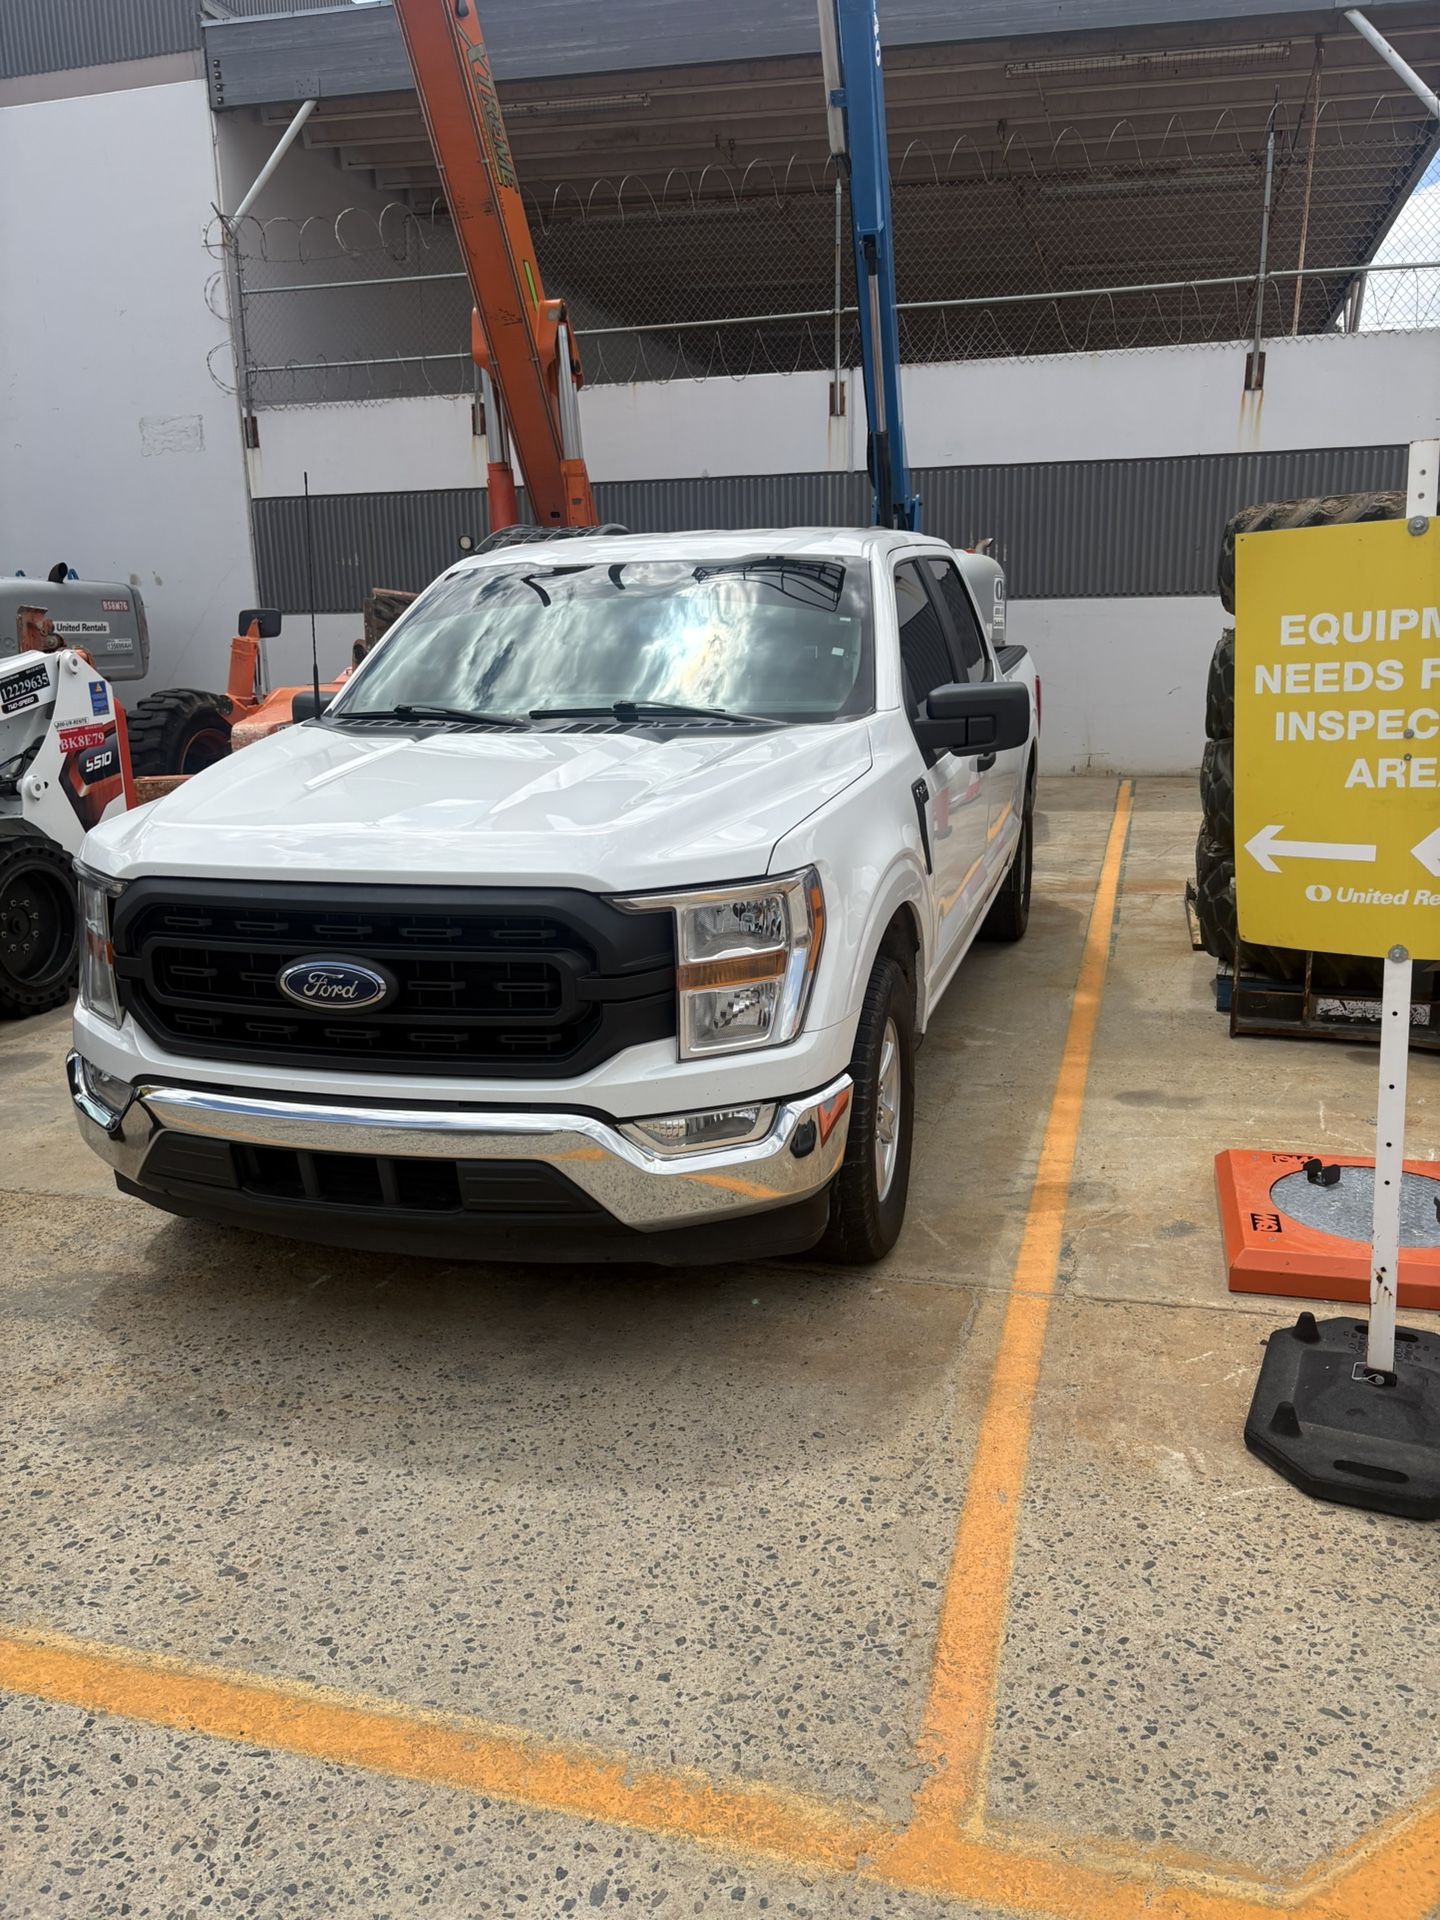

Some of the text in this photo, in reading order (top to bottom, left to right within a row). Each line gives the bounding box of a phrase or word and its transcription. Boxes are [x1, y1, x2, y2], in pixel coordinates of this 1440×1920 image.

[56, 623, 107, 632] United Rentals
[1, 672, 50, 700] 12229635
[1255, 659, 1404, 694] NEEDS
[8, 696, 35, 711] TWO-SPEED
[1275, 708, 1440, 741] INSPEC
[60, 732, 105, 750] BK8E79
[86, 751, 112, 773] S510
[1344, 757, 1440, 788] ARE
[1336, 887, 1409, 905] United
[303, 971, 358, 998] Ford
